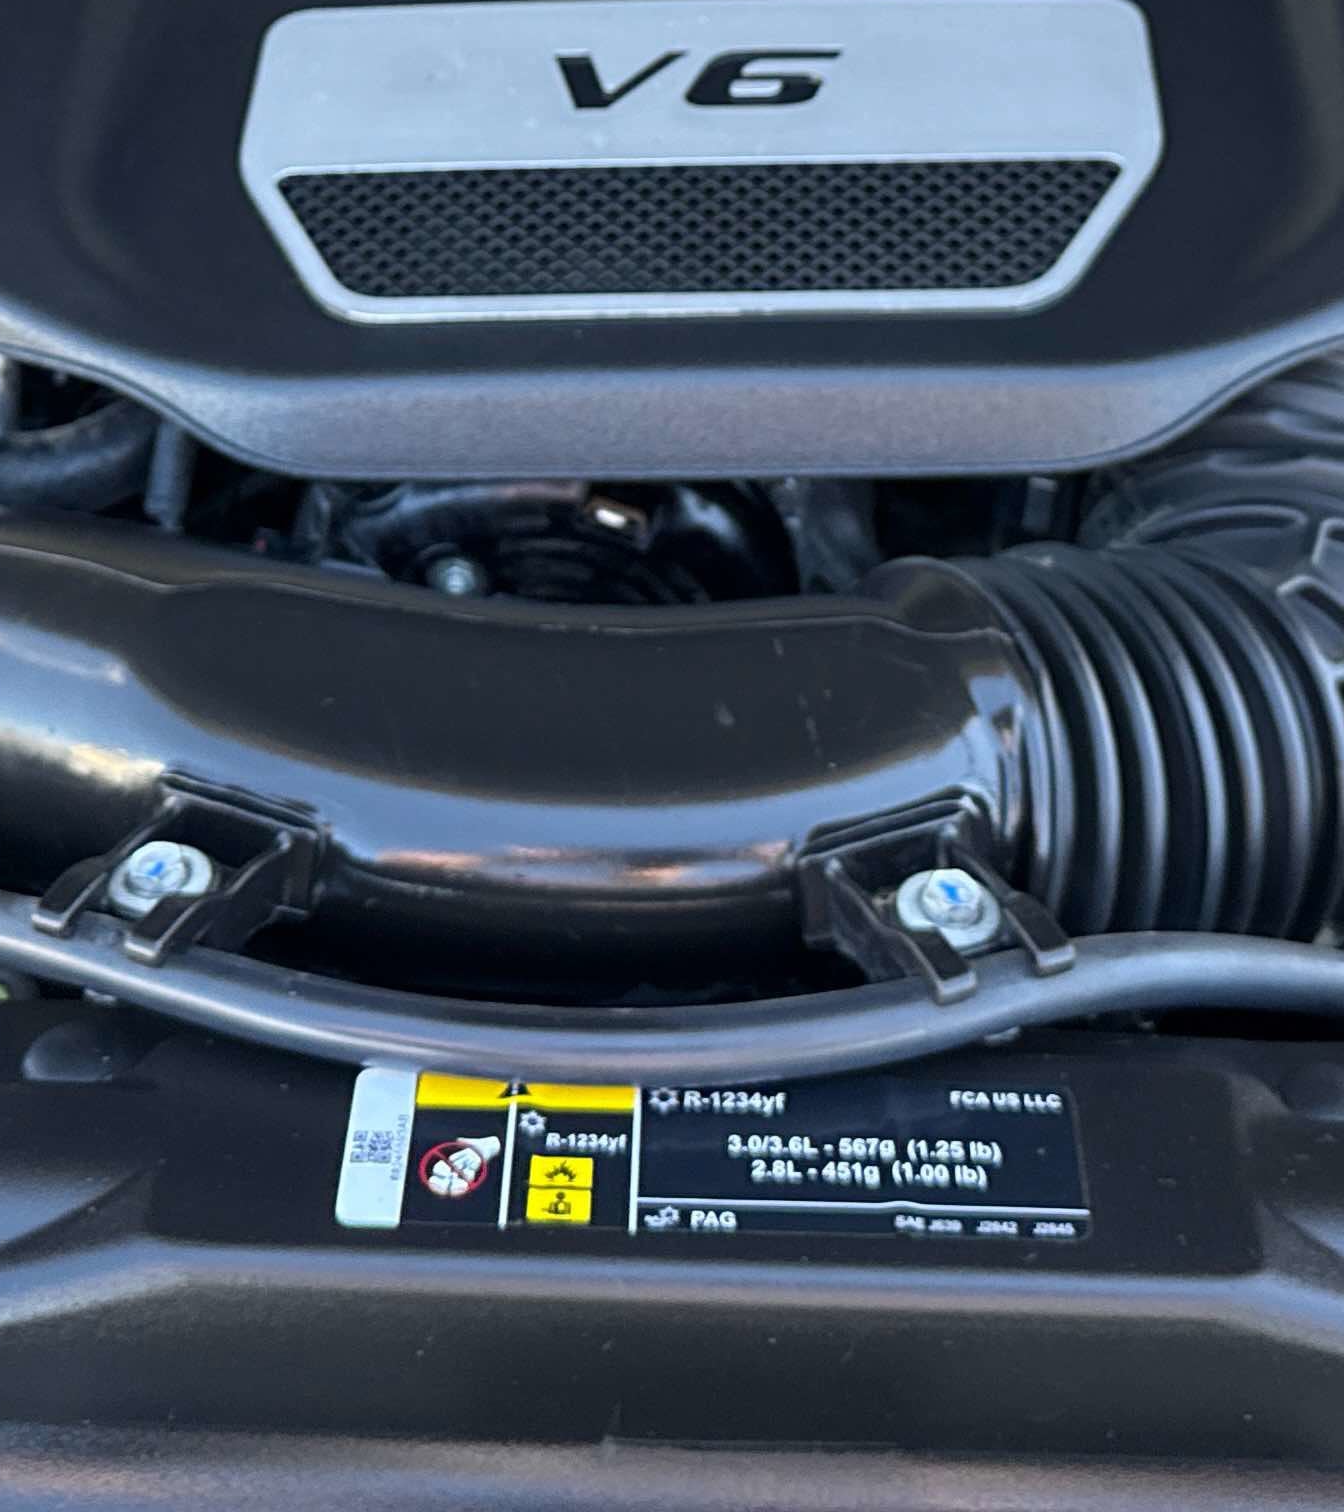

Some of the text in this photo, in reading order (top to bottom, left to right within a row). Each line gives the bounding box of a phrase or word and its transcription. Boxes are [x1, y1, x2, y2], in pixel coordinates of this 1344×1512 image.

[555, 44, 843, 109] V6
[683, 1090, 787, 1117] R-1234yf
[949, 1090, 1064, 1114] FCA US LLC
[545, 1132, 626, 1156] R-1234yf
[727, 1134, 819, 1159] 3.0/3.6L
[838, 1137, 896, 1164] 567g
[906, 1138, 966, 1164] (1.25
[968, 1141, 1003, 1168] lb)
[750, 1159, 803, 1184] 2.8L
[821, 1161, 881, 1190] 451g
[891, 1160, 951, 1190] (1.00
[954, 1164, 989, 1192] lb)
[690, 1210, 737, 1232] PAG
[894, 1214, 926, 1231] SAE
